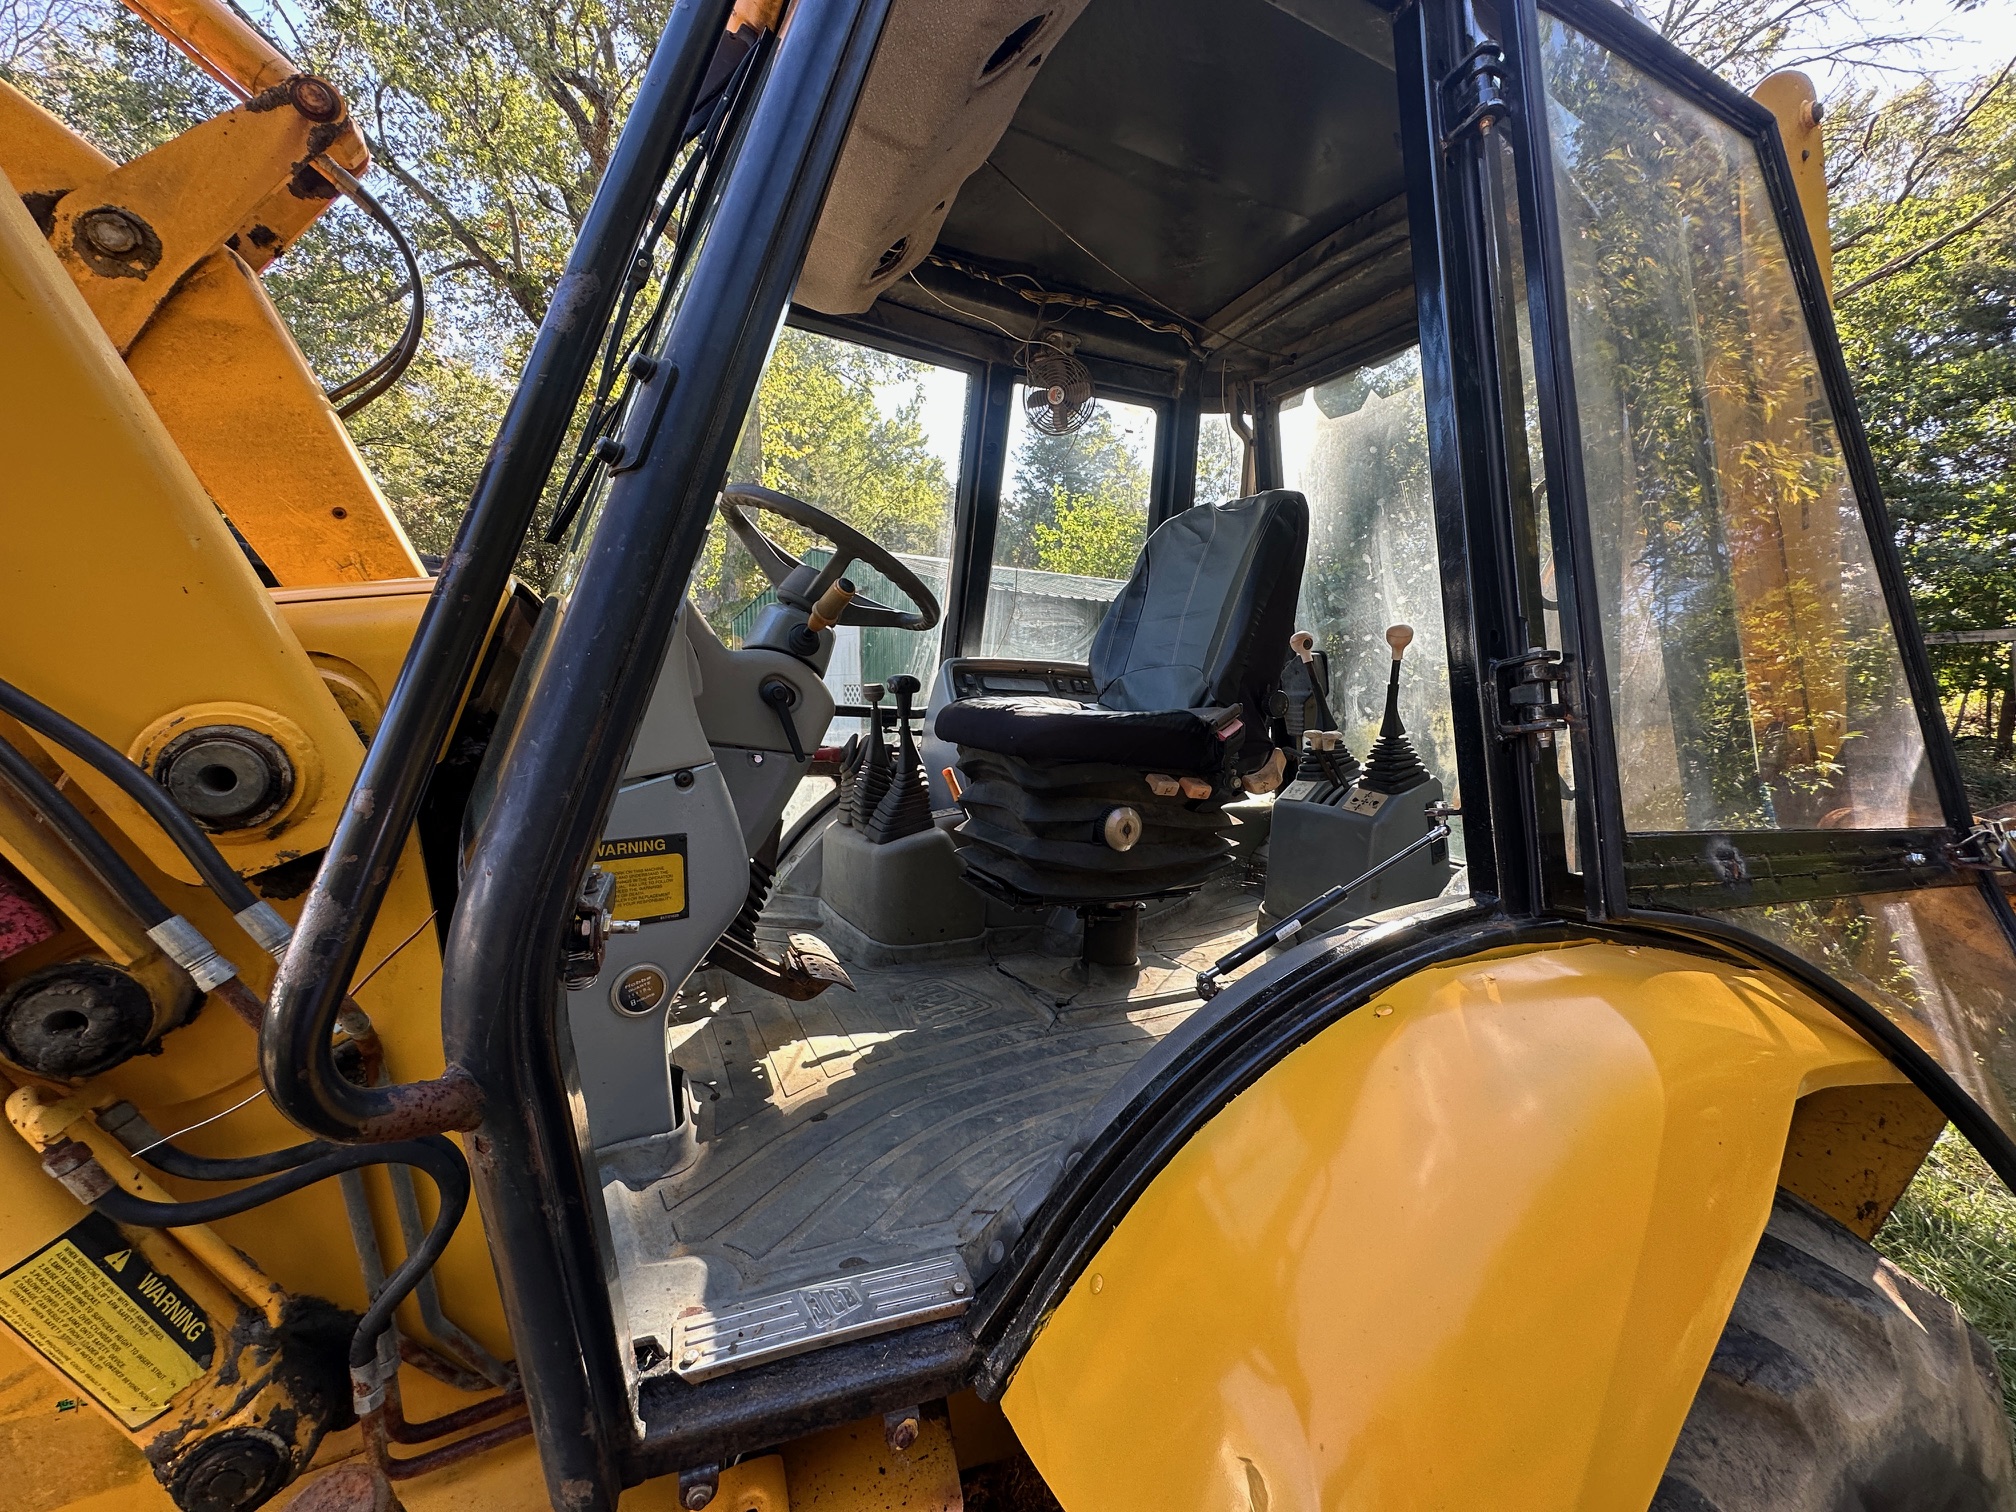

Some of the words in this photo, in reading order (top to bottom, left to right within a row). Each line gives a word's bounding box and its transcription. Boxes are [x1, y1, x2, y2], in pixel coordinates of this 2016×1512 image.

[9, 1288, 31, 1306] CONTACT
[30, 1307, 45, 1318] WHEN
[43, 1318, 61, 1333] SAFETY
[46, 1285, 66, 1301] SAFETY
[63, 1300, 80, 1314] STRUT
[78, 1314, 92, 1324] OVER
[89, 1324, 112, 1342] CYLINDER
[55, 1251, 73, 1267] ALWAYS
[72, 1267, 90, 1282] INSTALL
[88, 1282, 98, 1290] THE
[97, 1291, 108, 1299] LIFT
[107, 1300, 118, 1308] ARM
[117, 1309, 135, 1324] SAFETY
[64, 1246, 78, 1258] WHEN
[76, 1258, 99, 1278] SERVICING
[106, 1286, 118, 1296] UNIT
[116, 1296, 129, 1306] WITH
[127, 1306, 138, 1314] LIFT
[136, 1315, 149, 1325] ARMS
[65, 1274, 83, 1290] LOADER
[138, 1272, 206, 1342] WARNING
[807, 1287, 859, 1325] JCB
[35, 1299, 47, 1309] CAN
[45, 1309, 63, 1322] RESULT
[67, 1327, 82, 1340] FRONT
[102, 1360, 124, 1377] LOWERED
[41, 1293, 59, 1307] LOWER
[57, 1307, 69, 1316] LIFT
[67, 1316, 81, 1327] ARMS
[79, 1327, 93, 1338] ONTO
[91, 1338, 110, 1353] SAFETY
[56, 1279, 74, 1294] LOADER
[72, 1294, 87, 1306] ARMS
[91, 1312, 117, 1333] SUFFICIENT
[114, 1334, 132, 1347] HEIGHT
[136, 1353, 153, 1366] INSERT
[150, 1367, 166, 1379] STRUT
